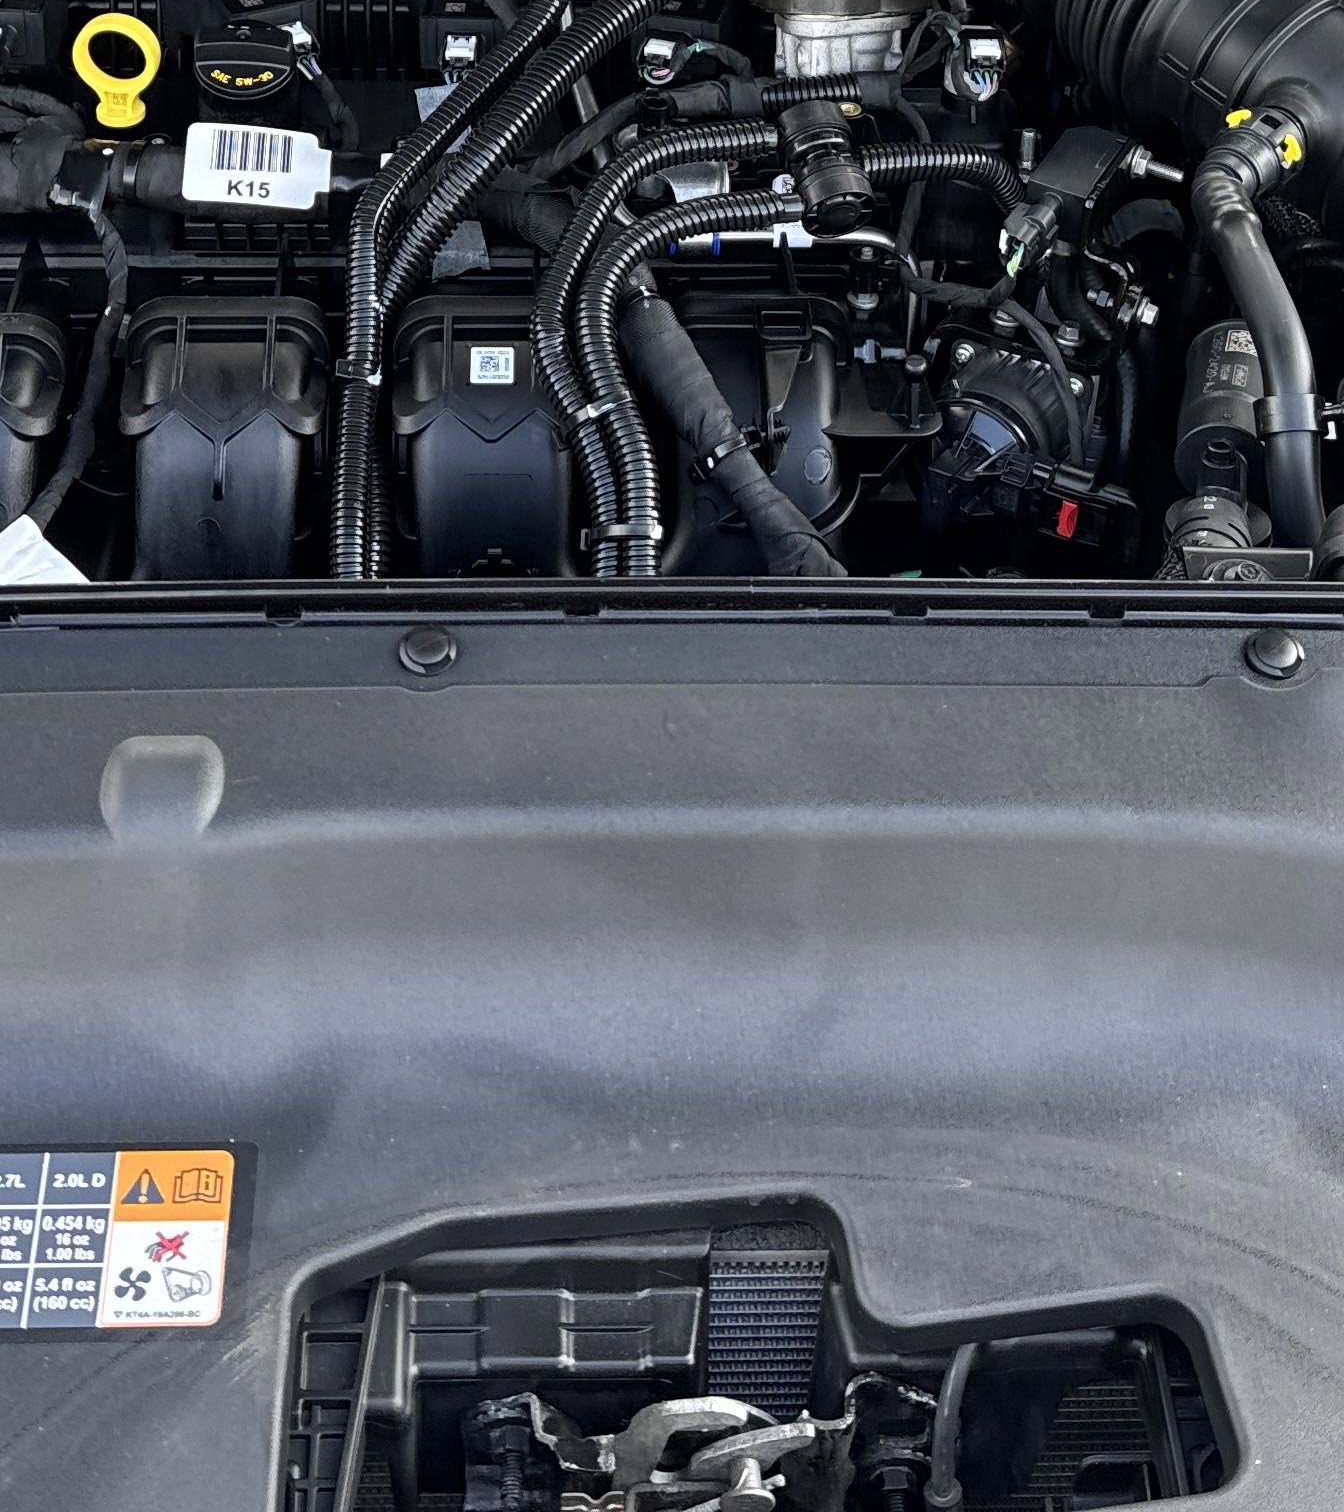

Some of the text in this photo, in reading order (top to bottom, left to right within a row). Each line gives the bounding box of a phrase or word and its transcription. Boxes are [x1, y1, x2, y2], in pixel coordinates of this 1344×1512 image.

[210, 69, 274, 86] SAE 5W-30
[227, 179, 271, 199] K15
[52, 1173, 106, 1188] 2.0L D
[13, 1216, 34, 1235] kg
[41, 1215, 106, 1234] 0.454 kg
[0, 1235, 18, 1247] oz
[55, 1233, 90, 1246] 16 oz
[0, 1248, 22, 1261] lbs
[45, 1247, 96, 1261] 1.00 lbs
[2, 1280, 24, 1293] oz
[34, 1277, 59, 1292] 5.4
[75, 1279, 96, 1292] oz
[33, 1296, 96, 1313] (160 cc)
